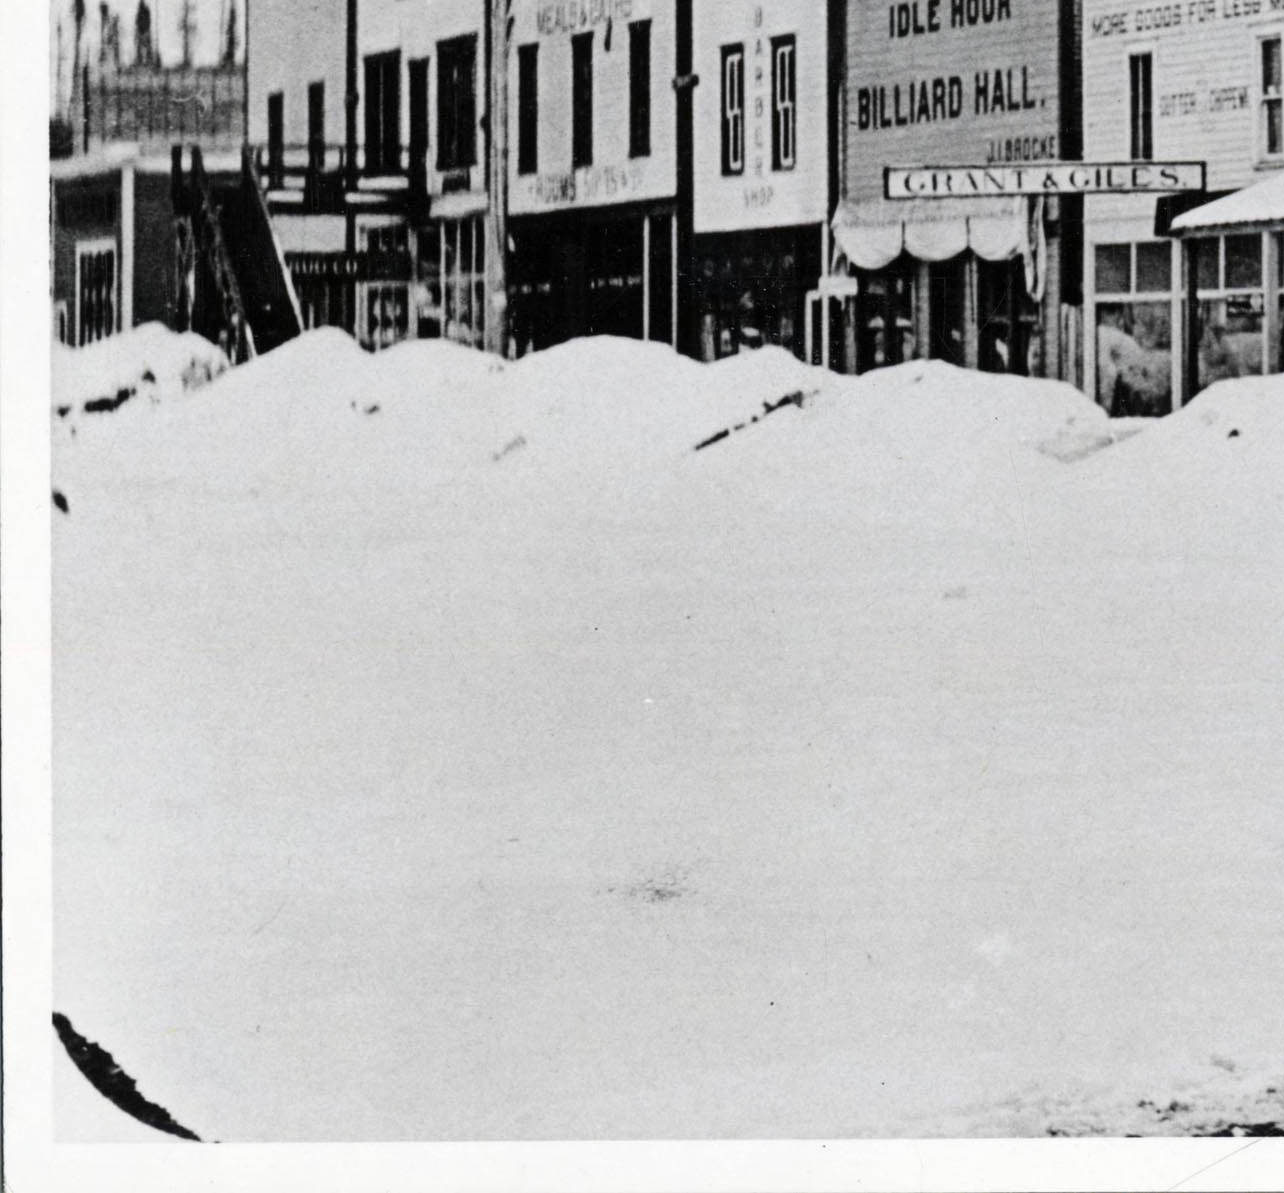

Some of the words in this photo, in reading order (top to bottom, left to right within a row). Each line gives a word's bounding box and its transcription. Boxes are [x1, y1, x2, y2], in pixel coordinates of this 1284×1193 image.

[1092, 12, 1128, 38] MORE
[1135, 3, 1182, 33] GOODS
[1187, 0, 1216, 24] FOR
[857, 75, 963, 131] BILLIARD
[903, 169, 1029, 194] GRANT
[1042, 171, 1059, 191] &
